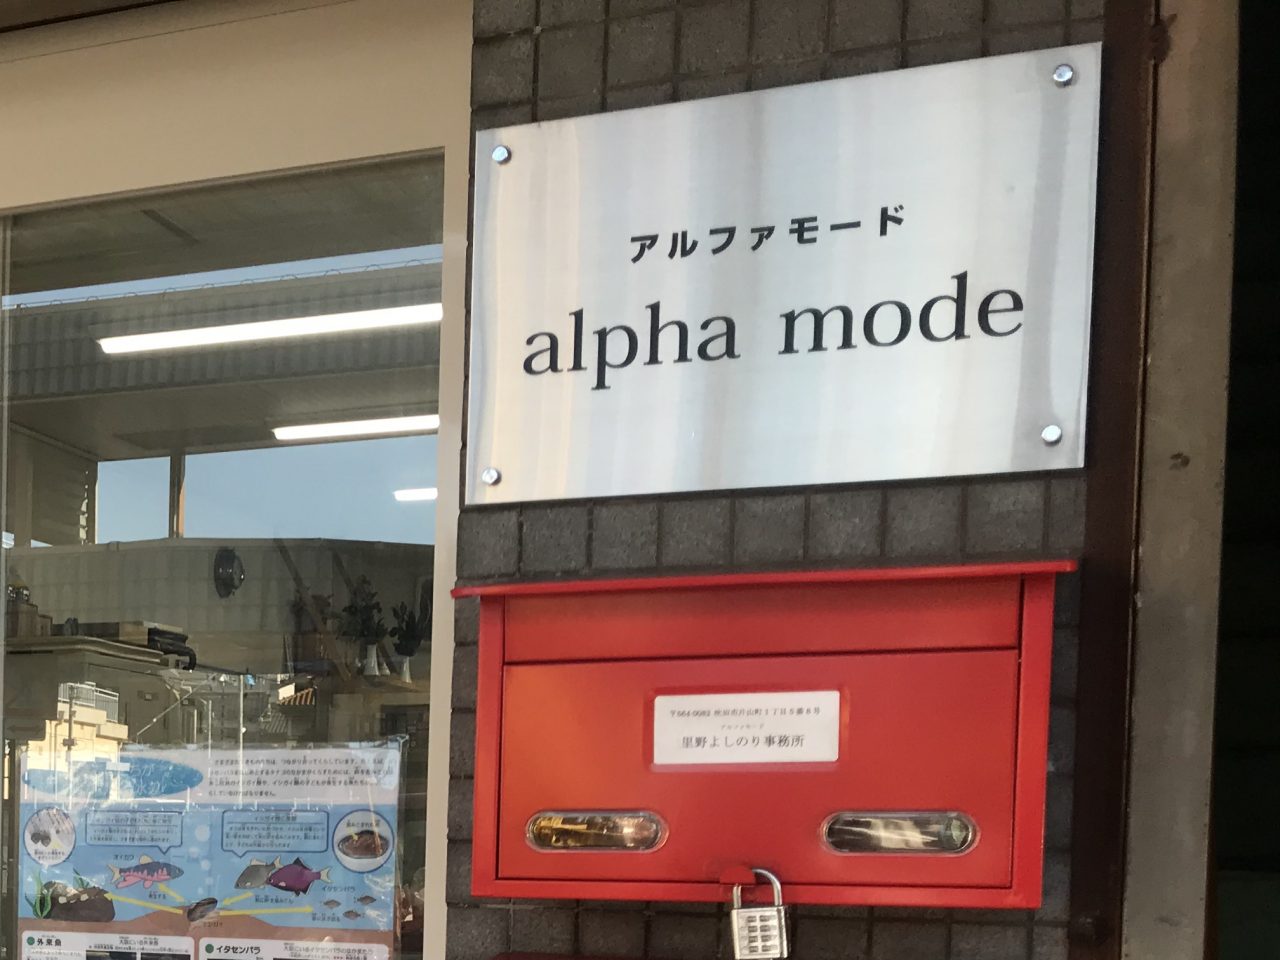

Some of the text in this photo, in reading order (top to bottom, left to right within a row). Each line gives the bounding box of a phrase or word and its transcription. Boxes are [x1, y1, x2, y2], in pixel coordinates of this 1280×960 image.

[630, 204, 905, 263] アルファモード
[522, 270, 1025, 391] alpha mode
[216, 945, 261, 954] イタセンパラ
